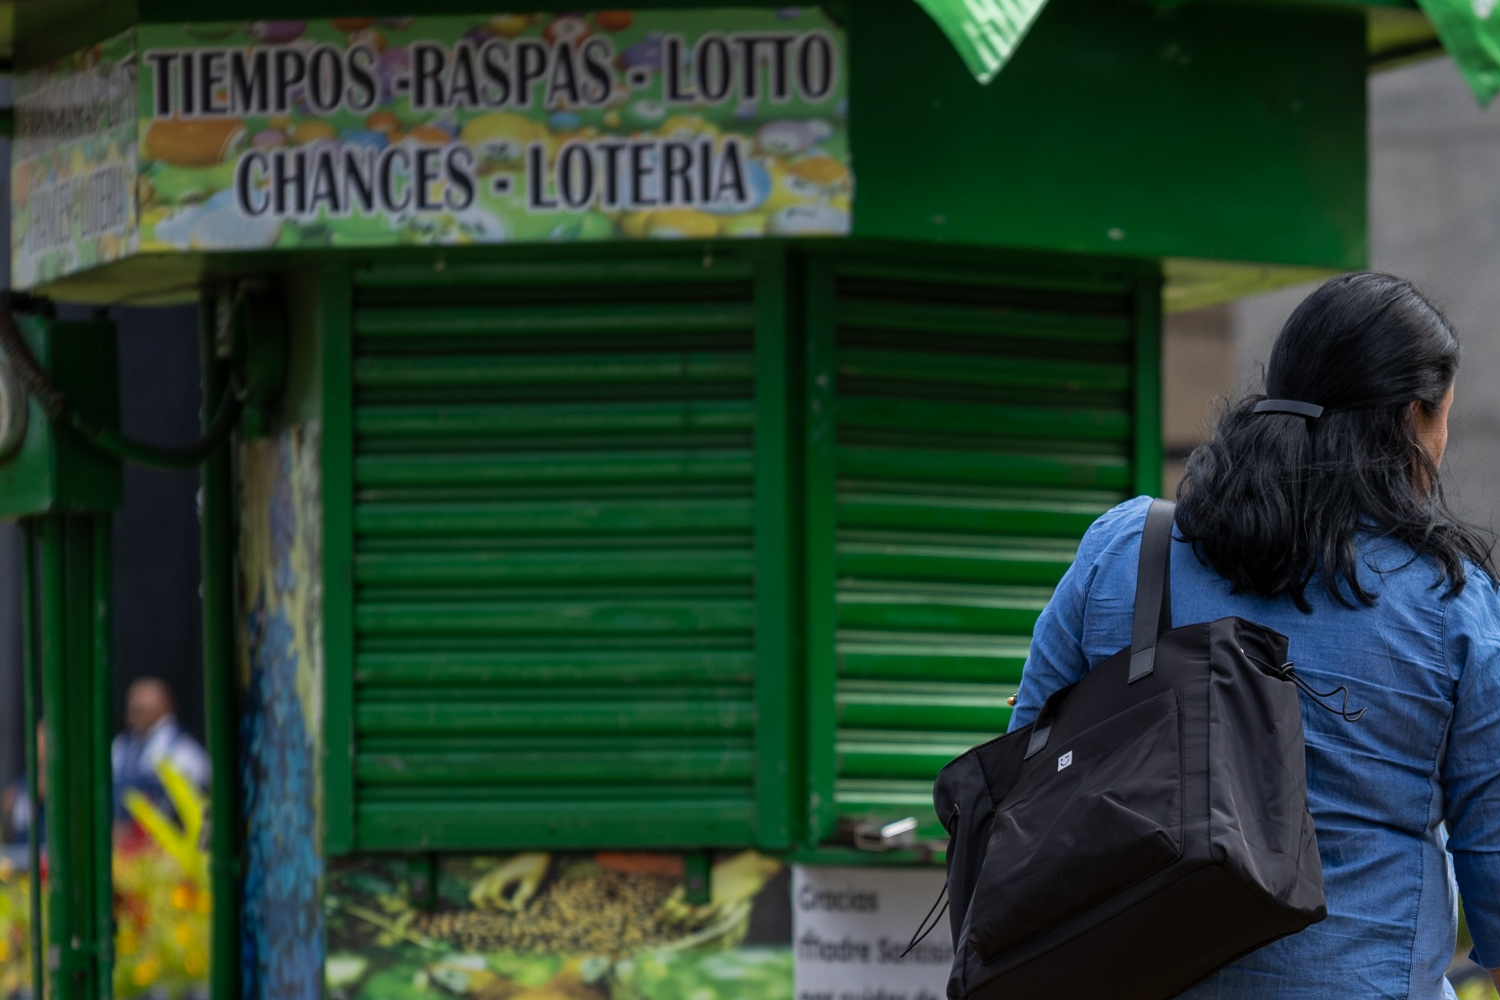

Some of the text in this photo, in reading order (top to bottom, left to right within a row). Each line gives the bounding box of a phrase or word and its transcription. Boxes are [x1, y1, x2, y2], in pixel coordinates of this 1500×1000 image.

[147, 45, 378, 116] TIEMPOS
[666, 33, 836, 102] LOTTO
[237, 146, 476, 217] CHANCES
[528, 138, 748, 209] LOTERIA
[799, 886, 878, 914] Gracias
